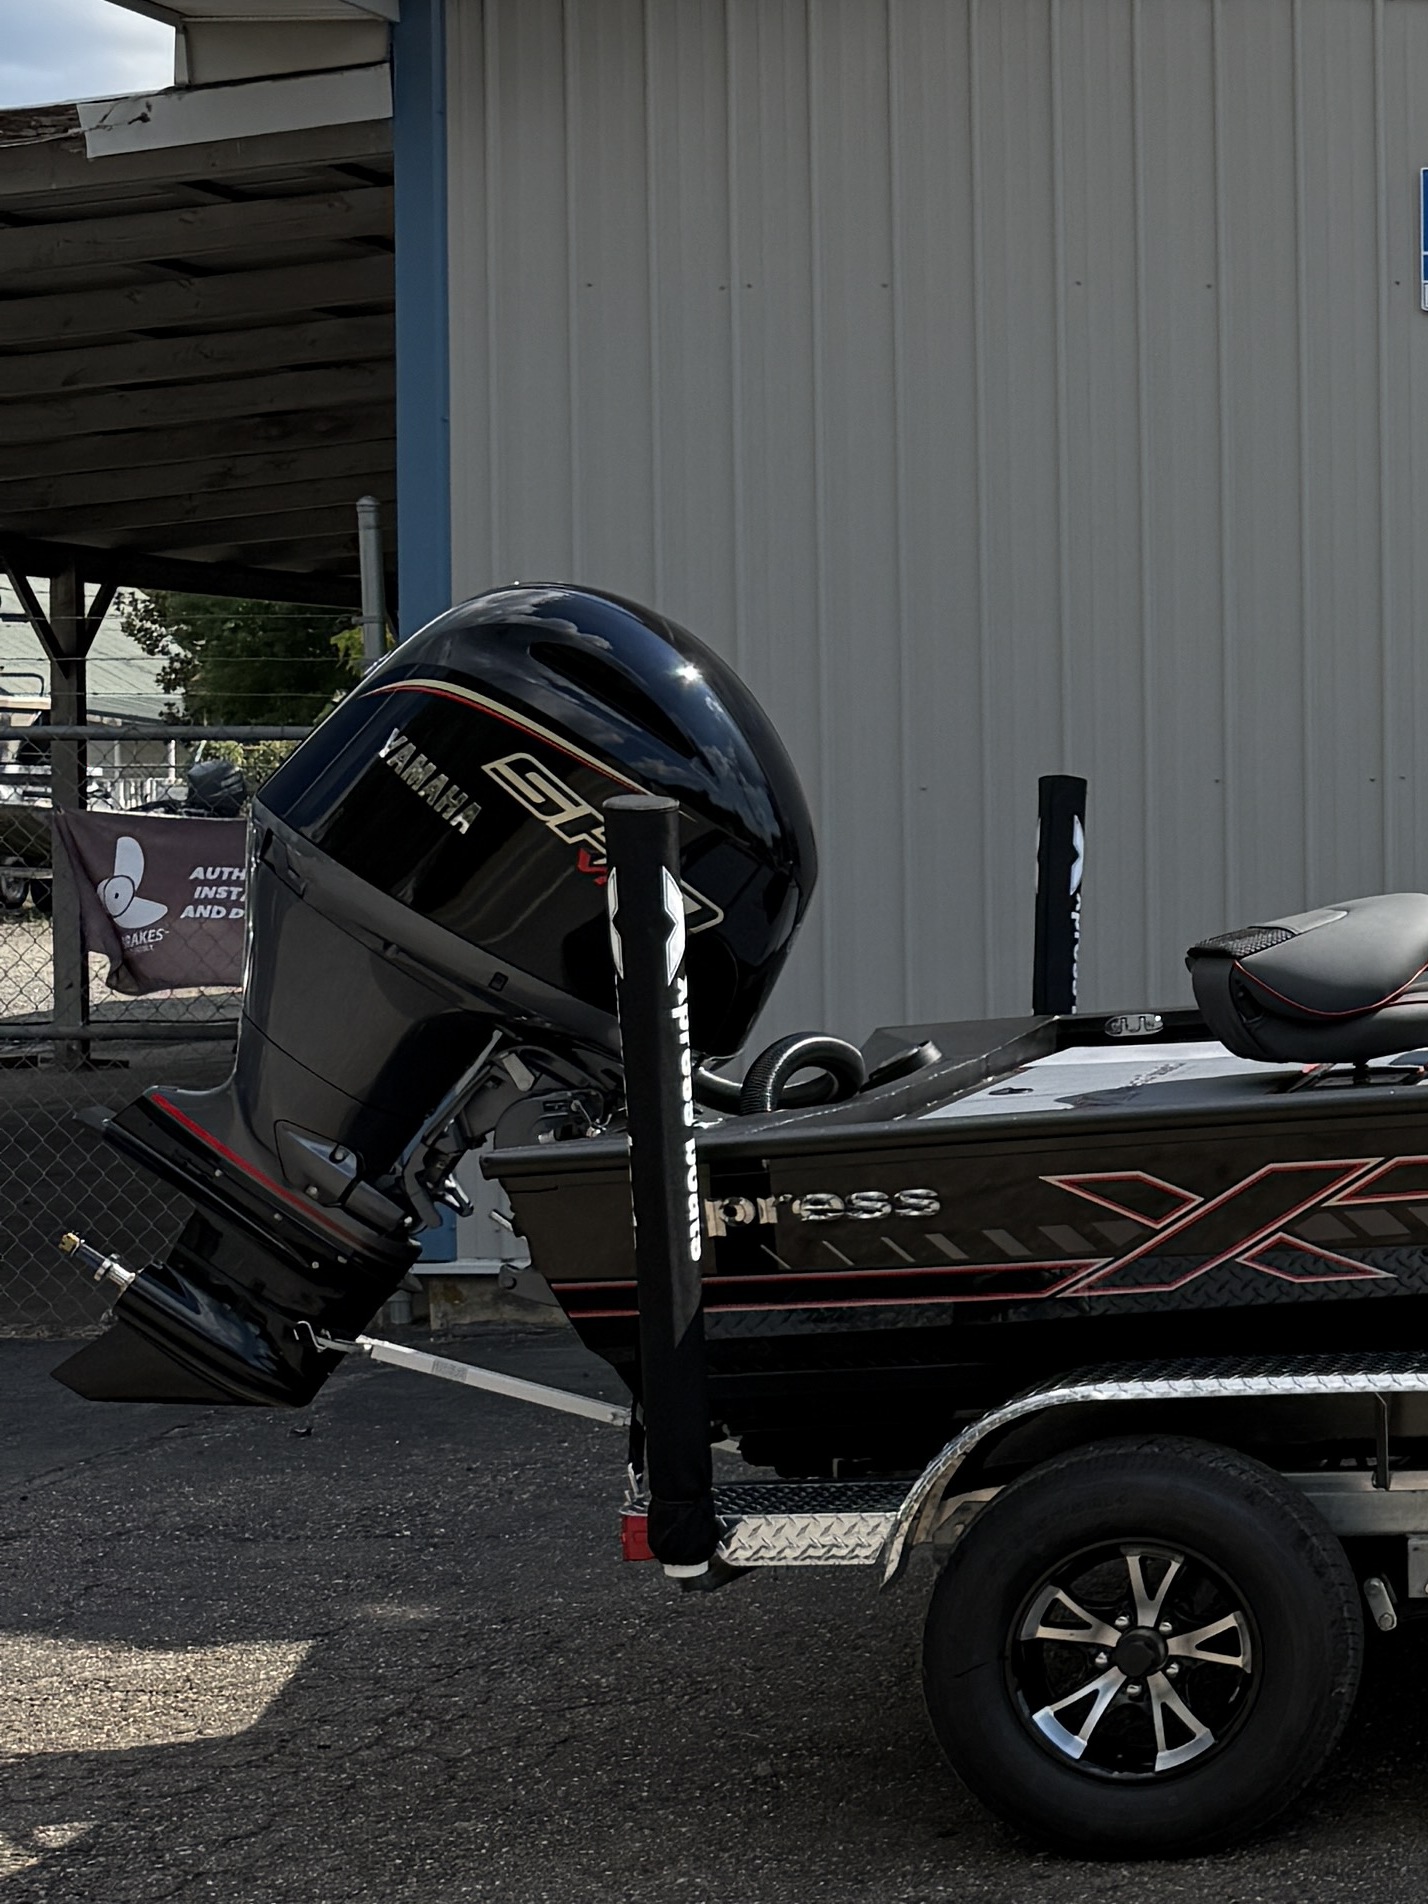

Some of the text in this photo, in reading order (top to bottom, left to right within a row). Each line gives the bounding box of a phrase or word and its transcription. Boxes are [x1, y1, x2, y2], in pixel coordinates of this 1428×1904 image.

[378, 727, 482, 834] YAMAHA
[194, 886, 246, 901] INST
[180, 905, 227, 919] AND
[704, 1188, 941, 1238] press
